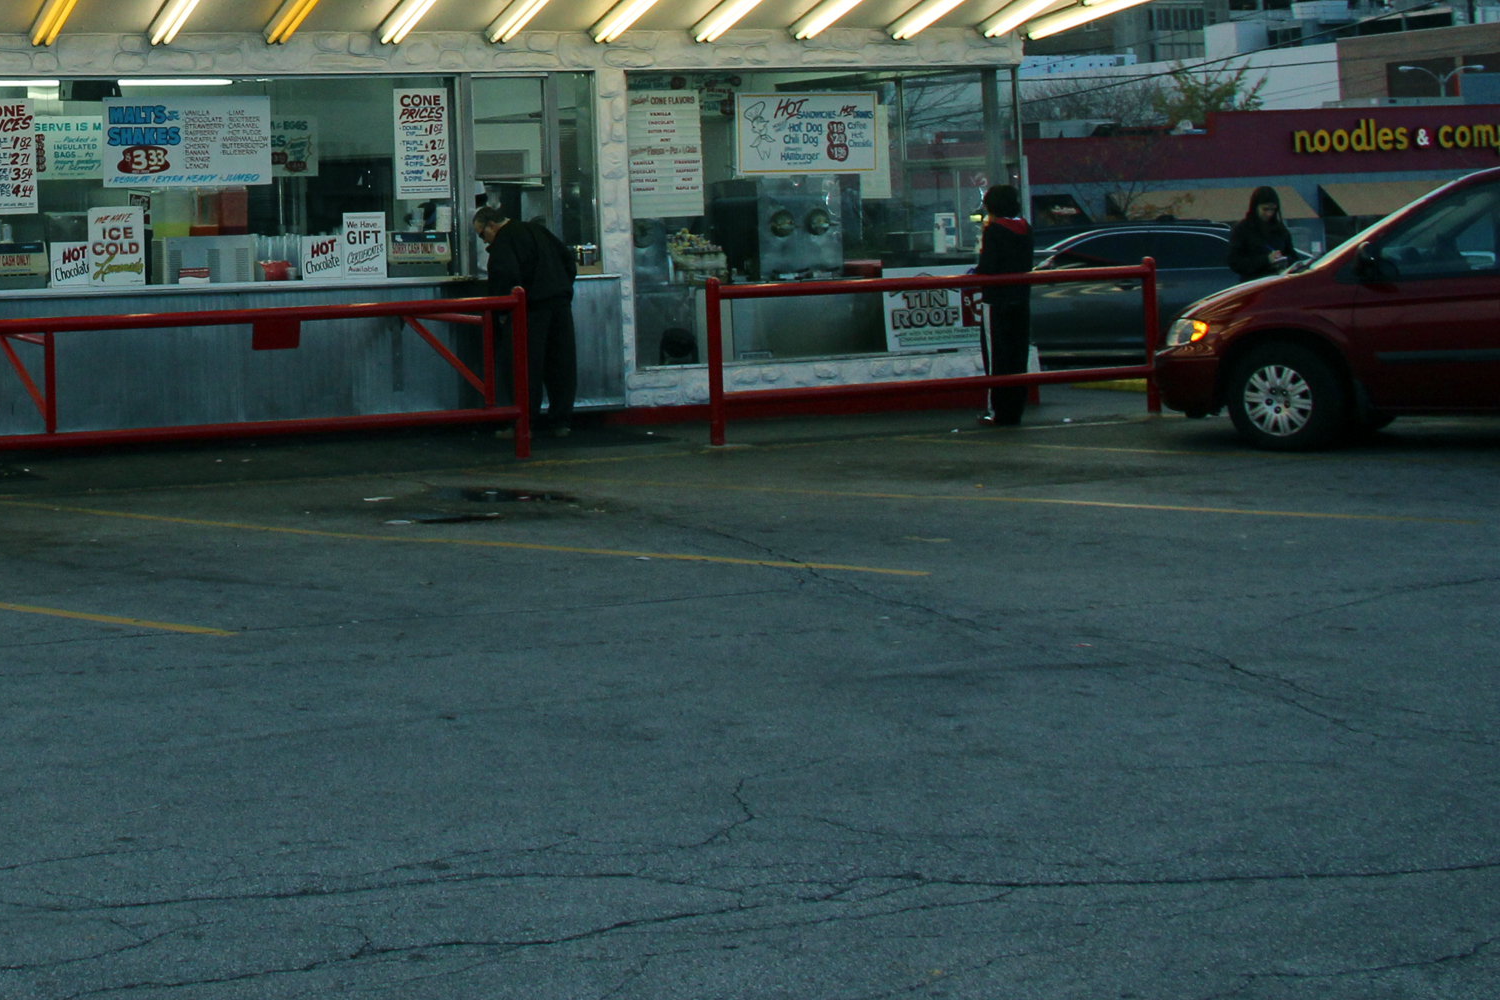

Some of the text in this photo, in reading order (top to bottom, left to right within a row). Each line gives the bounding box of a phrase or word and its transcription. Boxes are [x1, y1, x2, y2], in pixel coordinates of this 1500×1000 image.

[400, 94, 441, 107] CONE
[650, 96, 668, 106] CONE
[668, 95, 696, 105] FLAVORS
[108, 104, 167, 125] MALTS
[399, 106, 445, 120] PRICES
[773, 98, 874, 120] HOT SANDWICHES HOT DRINKS
[34, 122, 88, 132] SERVE IS
[283, 120, 308, 131] EGGS
[787, 121, 804, 133] Hot
[805, 122, 823, 136] Dog
[847, 121, 868, 130] Coffee
[106, 126, 182, 147] SHAKES
[782, 134, 800, 145] Chili
[802, 133, 820, 147] Dog
[851, 131, 865, 139] Hot
[1293, 118, 1409, 152] noodles
[1438, 124, 1500, 155] com
[53, 143, 98, 151] INSULATED
[53, 151, 77, 159] BAGS
[112, 173, 260, 184] REGULAR EXTRA HEAVY JUMBO
[110, 212, 134, 223] HAVE
[346, 220, 358, 229] We
[102, 226, 135, 241] ICE
[346, 230, 382, 245] GIFT
[62, 245, 88, 265] HOT
[91, 242, 141, 256] COLD
[310, 238, 338, 259] HOT
[346, 243, 384, 265] CERTIFICATES
[391, 243, 408, 255] SORRY
[408, 243, 421, 254] CASH
[1, 255, 16, 267] CASH
[16, 254, 32, 266] ONLY!
[305, 254, 341, 275] Chocolate
[92, 254, 144, 283] Lemonade
[347, 265, 379, 273] Available
[902, 288, 949, 310] TIN
[891, 306, 961, 330] ROOF
